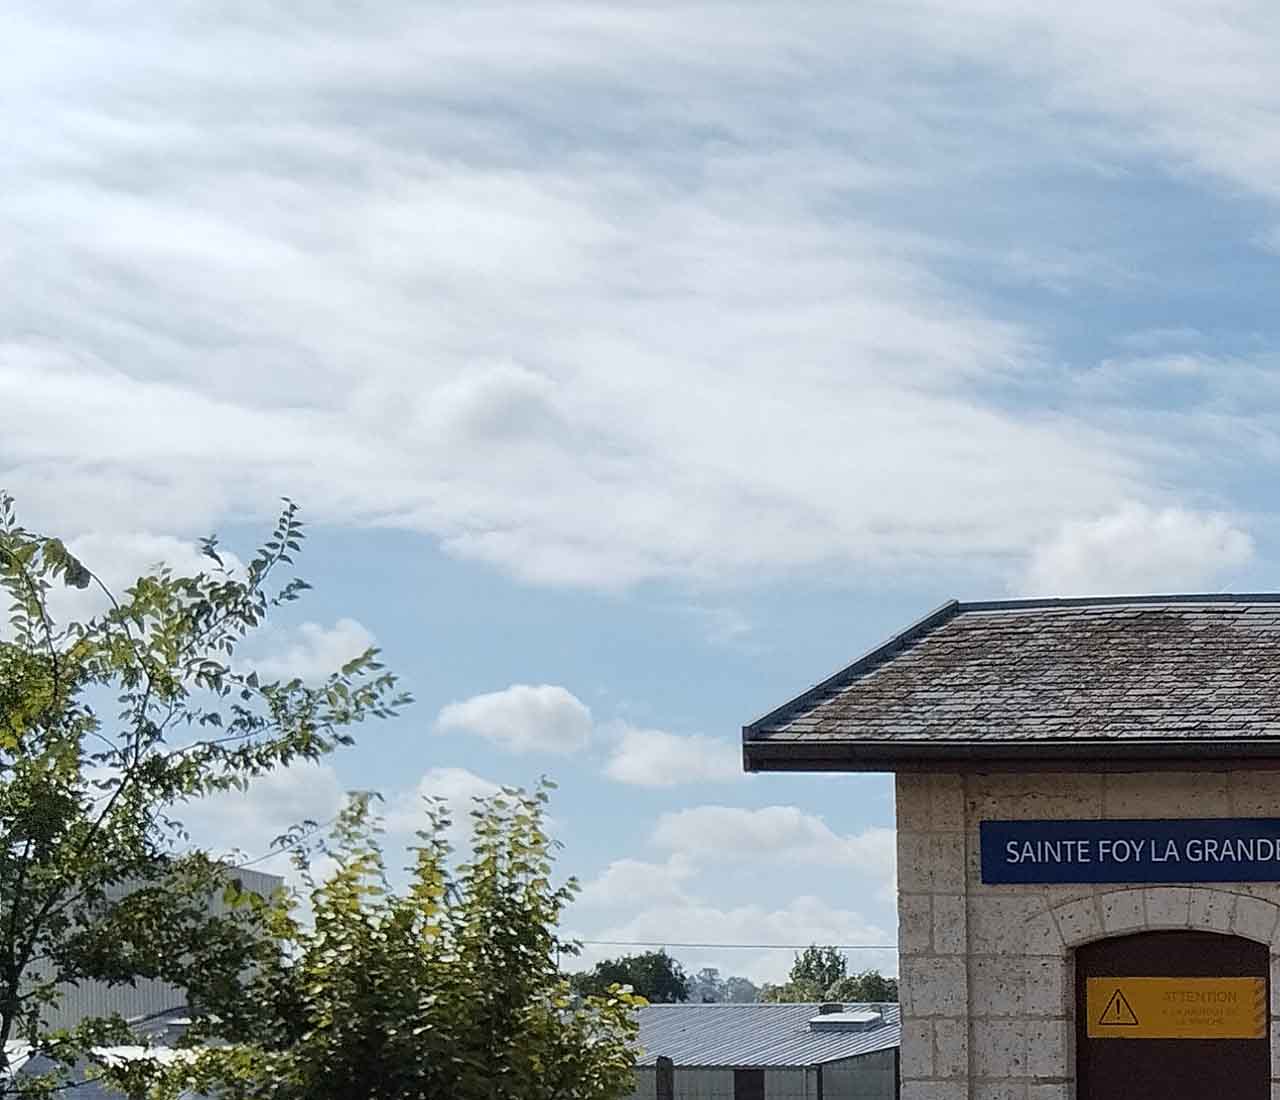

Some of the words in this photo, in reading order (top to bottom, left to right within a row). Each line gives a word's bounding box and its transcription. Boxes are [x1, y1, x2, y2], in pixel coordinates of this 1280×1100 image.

[1005, 840, 1090, 864] SAINTE
[1099, 839, 1146, 863] FOY
[1151, 839, 1181, 862] LA
